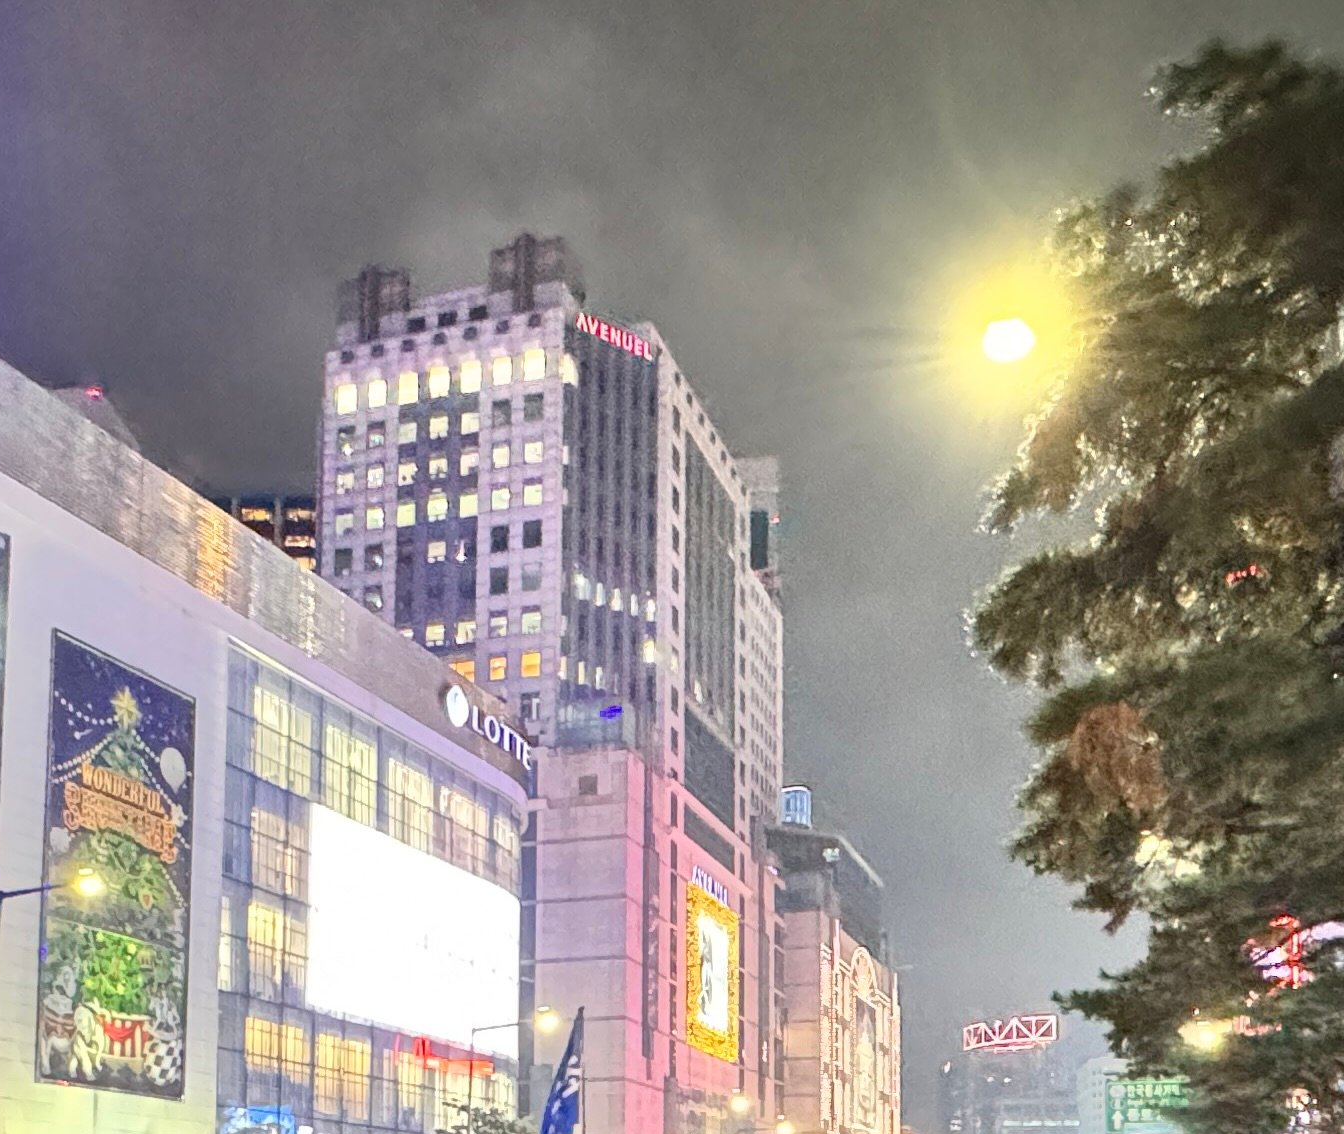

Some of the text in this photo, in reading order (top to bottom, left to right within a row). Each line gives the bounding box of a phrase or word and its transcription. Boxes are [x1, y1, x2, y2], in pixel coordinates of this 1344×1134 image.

[576, 311, 653, 361] AVENUEL
[472, 705, 532, 771] LOTTE
[81, 763, 167, 815] WONDERFUL
